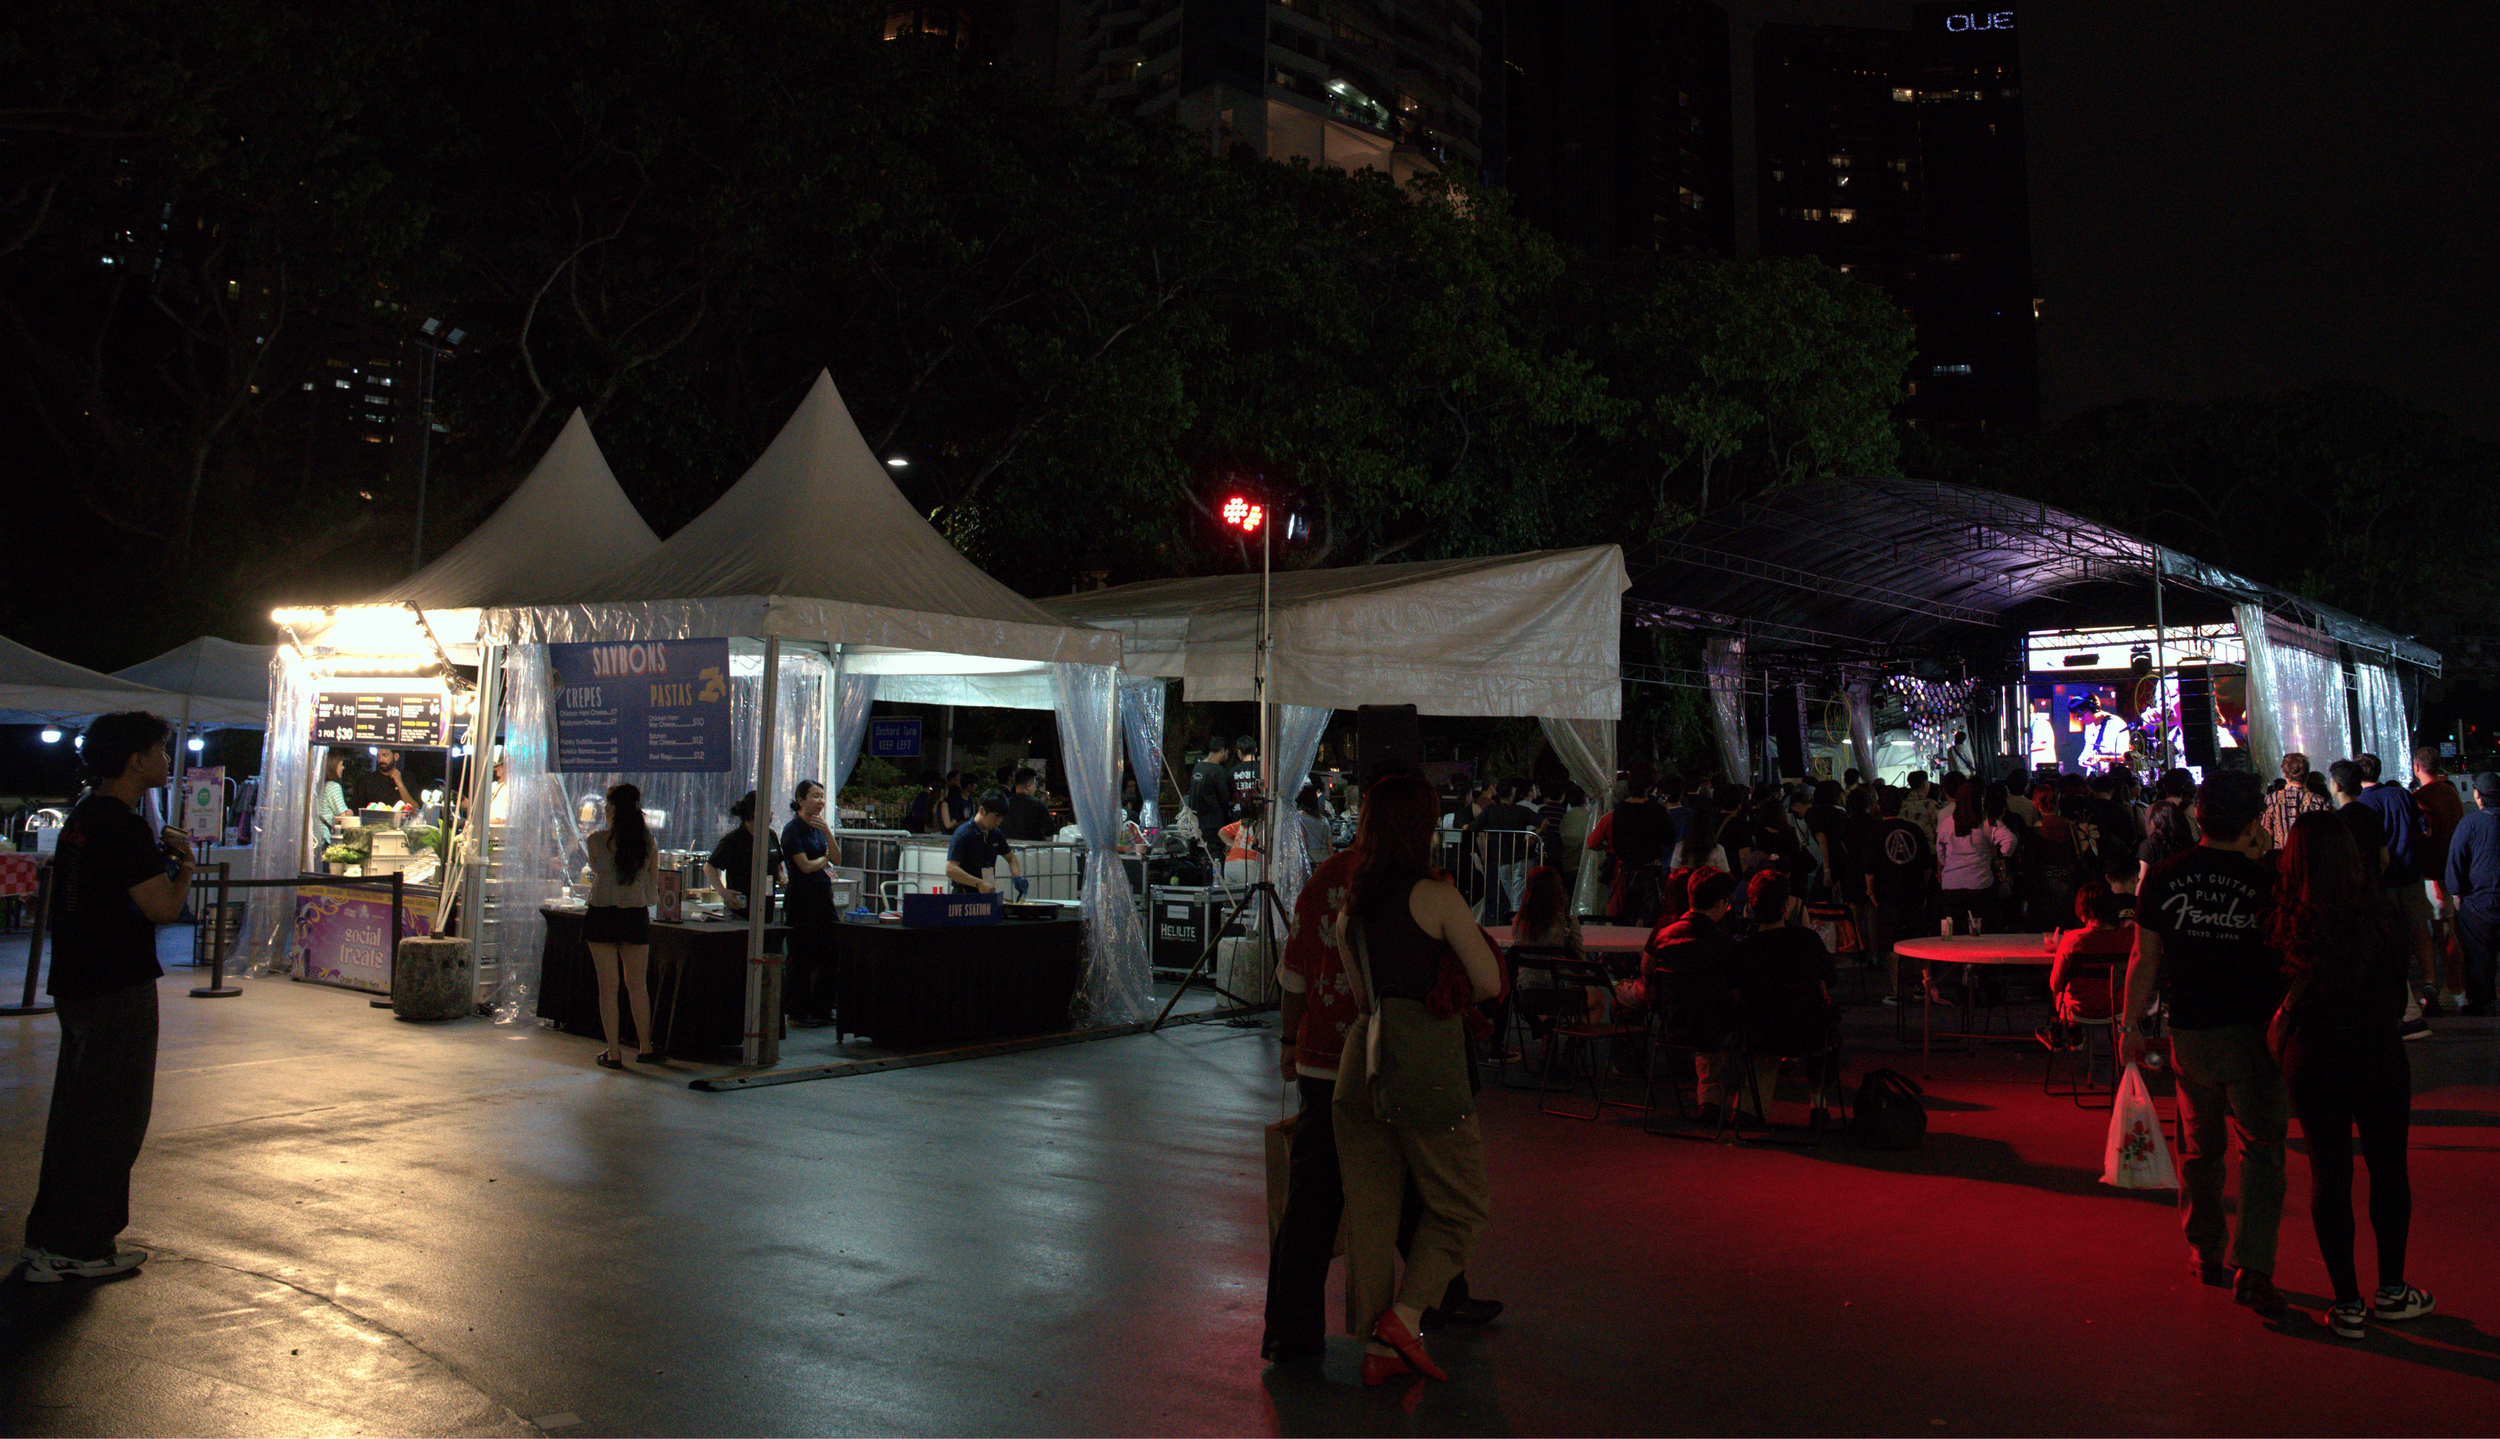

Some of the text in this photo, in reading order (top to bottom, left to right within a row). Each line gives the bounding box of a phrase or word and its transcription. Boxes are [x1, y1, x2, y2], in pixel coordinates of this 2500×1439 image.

[1947, 11, 2014, 32] OUE
[592, 642, 666, 678] SAYBONS
[566, 686, 602, 708] CREPES
[650, 683, 692, 708] PASTAS
[342, 705, 355, 716] $12
[693, 718, 704, 726] $10
[336, 726, 353, 741] $30
[876, 726, 900, 736] Orchard
[692, 736, 704, 744] $12
[879, 739, 911, 750] KEEP LEFT
[694, 751, 704, 760] $12
[2169, 874, 2256, 899] PLAY GUITAR
[2196, 890, 2226, 903] PLAY
[948, 903, 991, 917] LIVE STATION
[2160, 893, 2258, 930] Fender
[345, 925, 381, 947] social
[1160, 923, 1196, 938] HELILITE
[2215, 932, 2239, 940] JAPAN
[340, 943, 384, 970] treats
